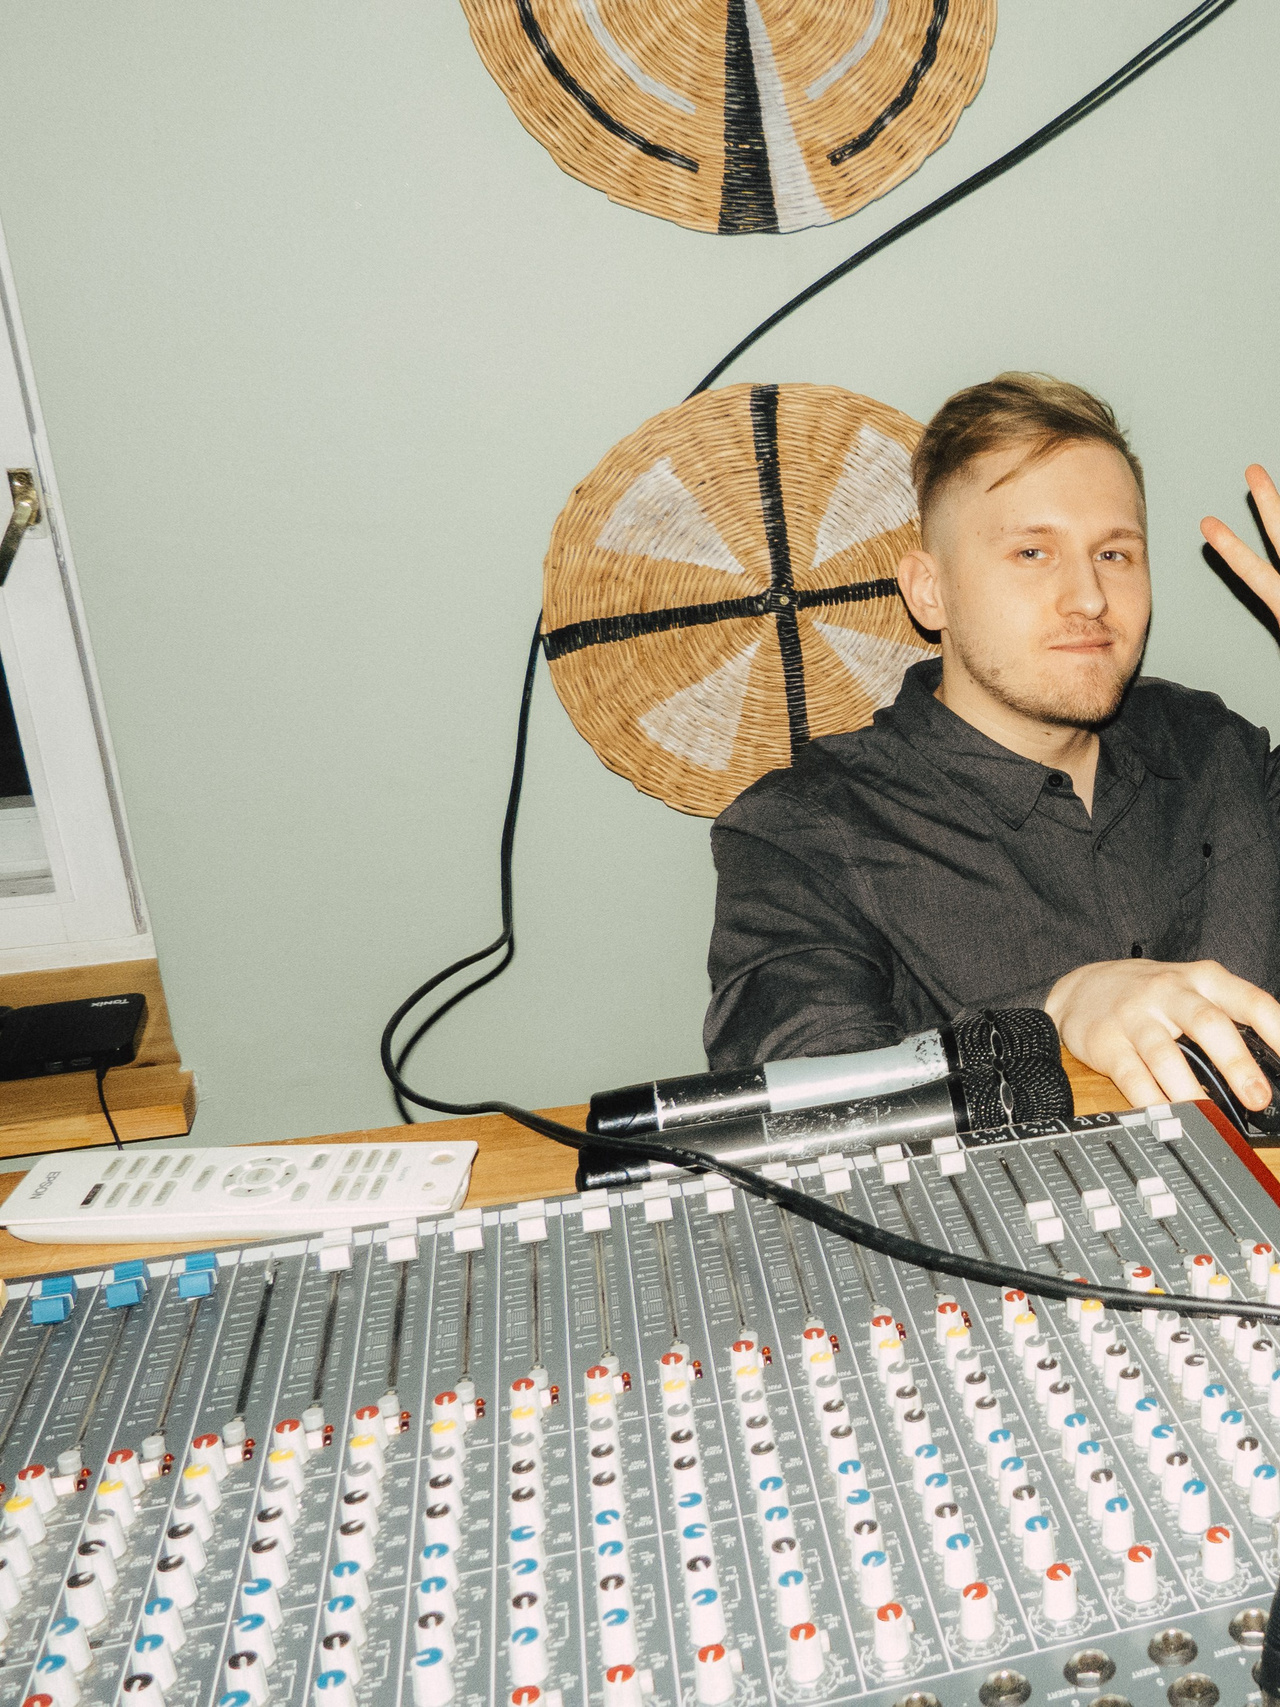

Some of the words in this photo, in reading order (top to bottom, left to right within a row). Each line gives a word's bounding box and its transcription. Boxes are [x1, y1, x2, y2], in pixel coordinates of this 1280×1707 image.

[1028, 1125, 1058, 1133] mic
[979, 1135, 1007, 1143] mic
[29, 1171, 62, 1199] EPSON
[1213, 1645, 1241, 1657] INSERT
[1238, 1657, 1245, 1665] 4
[1131, 1666, 1160, 1678] INSERT
[1156, 1678, 1164, 1686] 5
[1047, 1688, 1076, 1700] INSERT
[1246, 1691, 1261, 1700] INE
